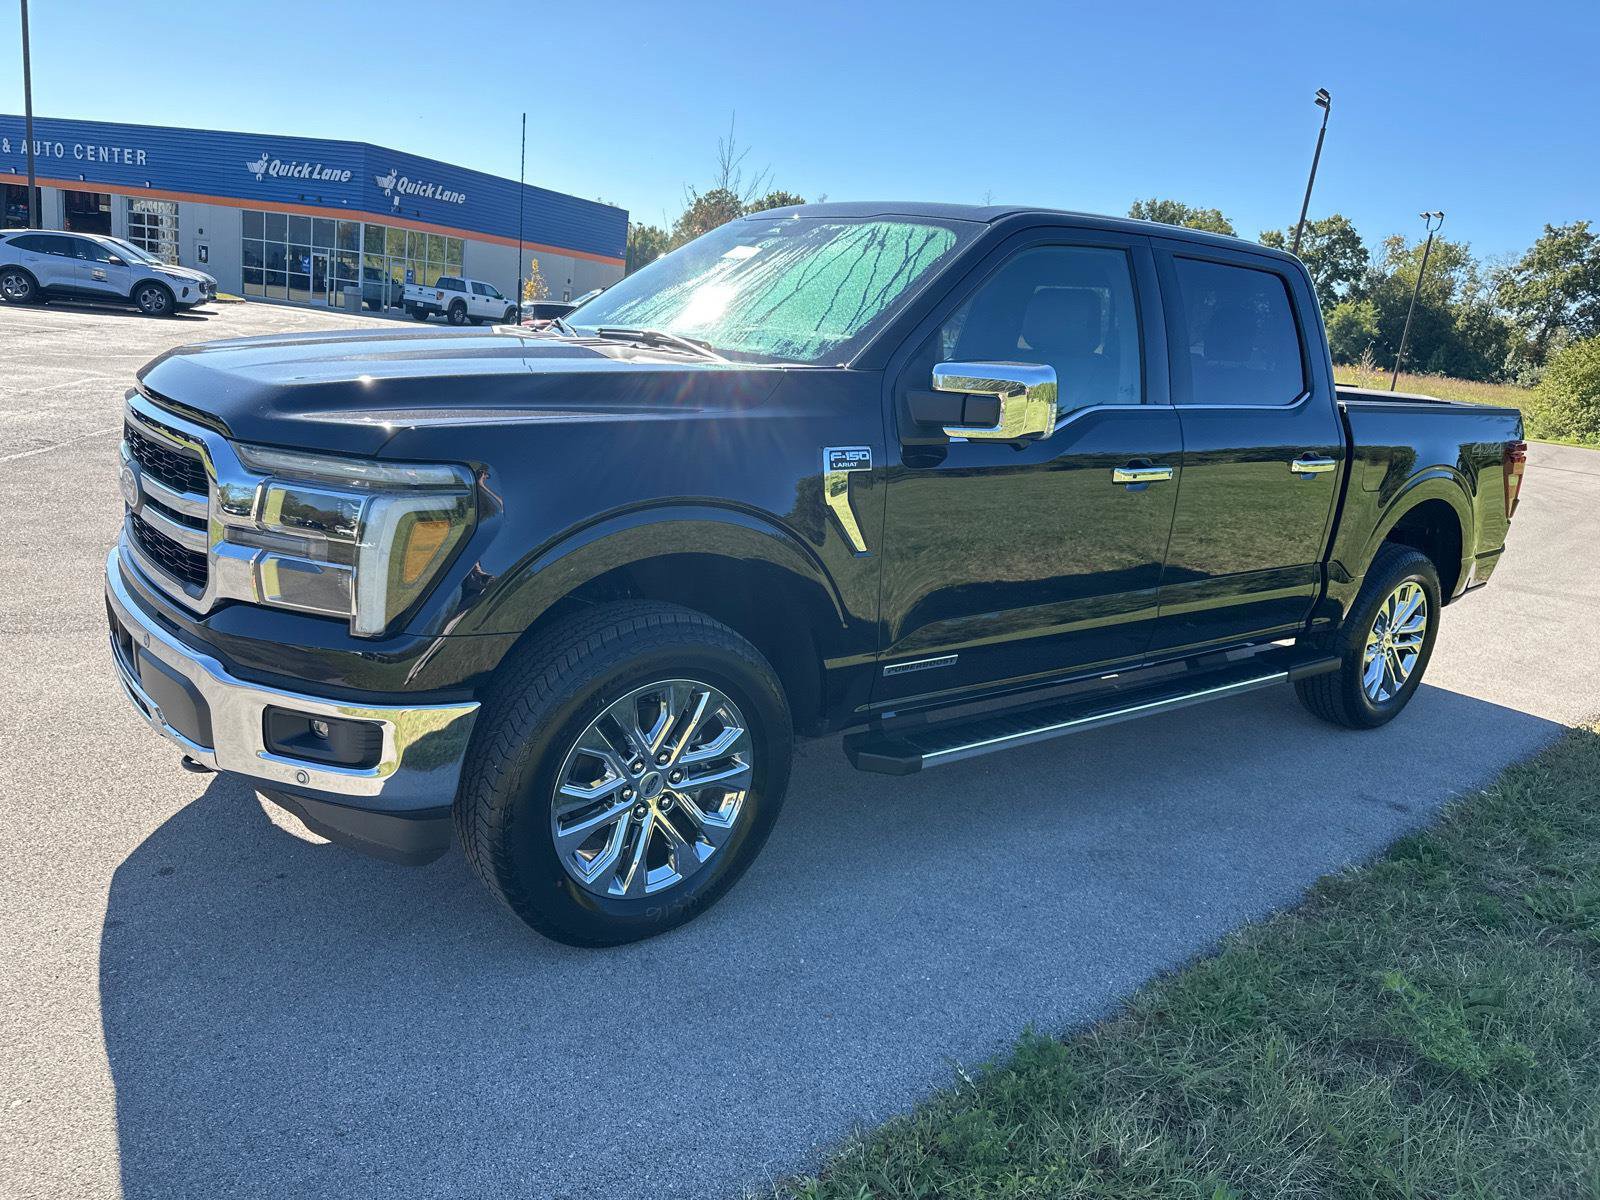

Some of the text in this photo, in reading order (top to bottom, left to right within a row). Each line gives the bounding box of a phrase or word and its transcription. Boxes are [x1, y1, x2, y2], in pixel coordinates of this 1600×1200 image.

[2, 138, 147, 165] & AUTO CENTER
[830, 451, 869, 461] F-150
